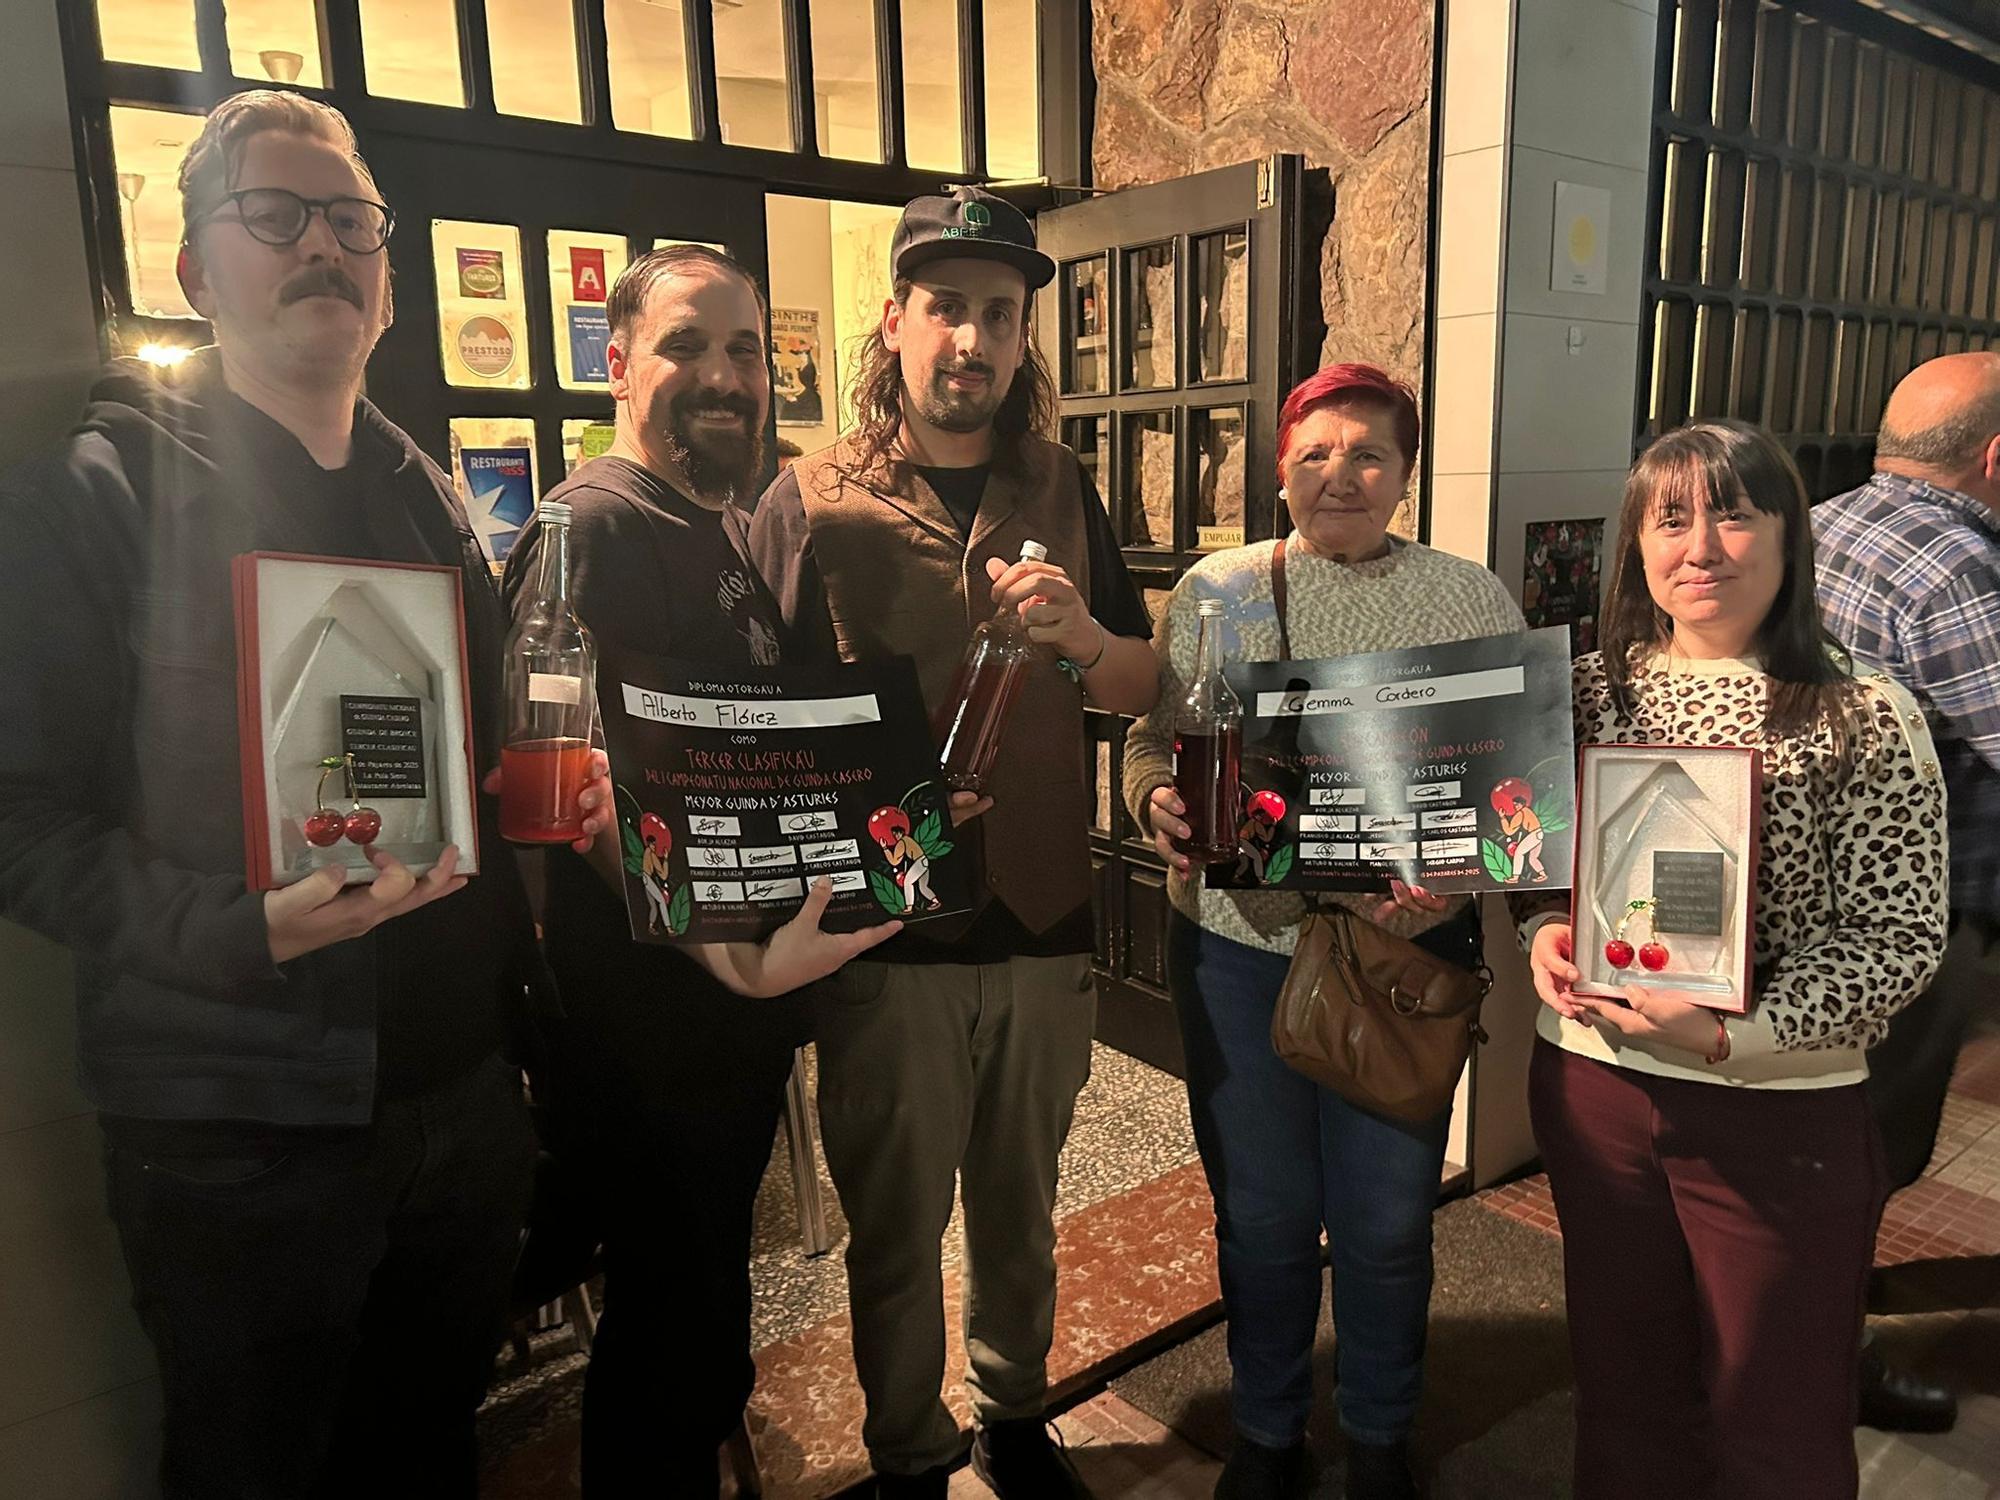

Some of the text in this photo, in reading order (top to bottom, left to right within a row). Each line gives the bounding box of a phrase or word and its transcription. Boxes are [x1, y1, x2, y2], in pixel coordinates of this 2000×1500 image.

[771, 311, 818, 322] SINTHE
[462, 346, 512, 355] PRESTOSO
[1204, 533, 1241, 543] EMPUJAR
[688, 681, 782, 695] DIPLOMA OTORGAU A
[1288, 686, 1436, 713] Gemma Cordero
[641, 693, 779, 726] Alberto Flórez
[730, 734, 757, 745] COMO
[1426, 744, 1463, 760] GUINDA
[1465, 738, 1505, 755] CASERO
[685, 749, 815, 771] TERCER CLASIFICAU
[666, 771, 727, 790] CAMPEONATU
[728, 775, 776, 790] NACIONAL
[777, 774, 792, 788] DE
[793, 772, 831, 788] GUINDA
[832, 767, 873, 784] CASERO
[1310, 772, 1351, 783] MEYOR
[685, 795, 723, 809] MEYOR
[725, 796, 768, 810] GUINDA
